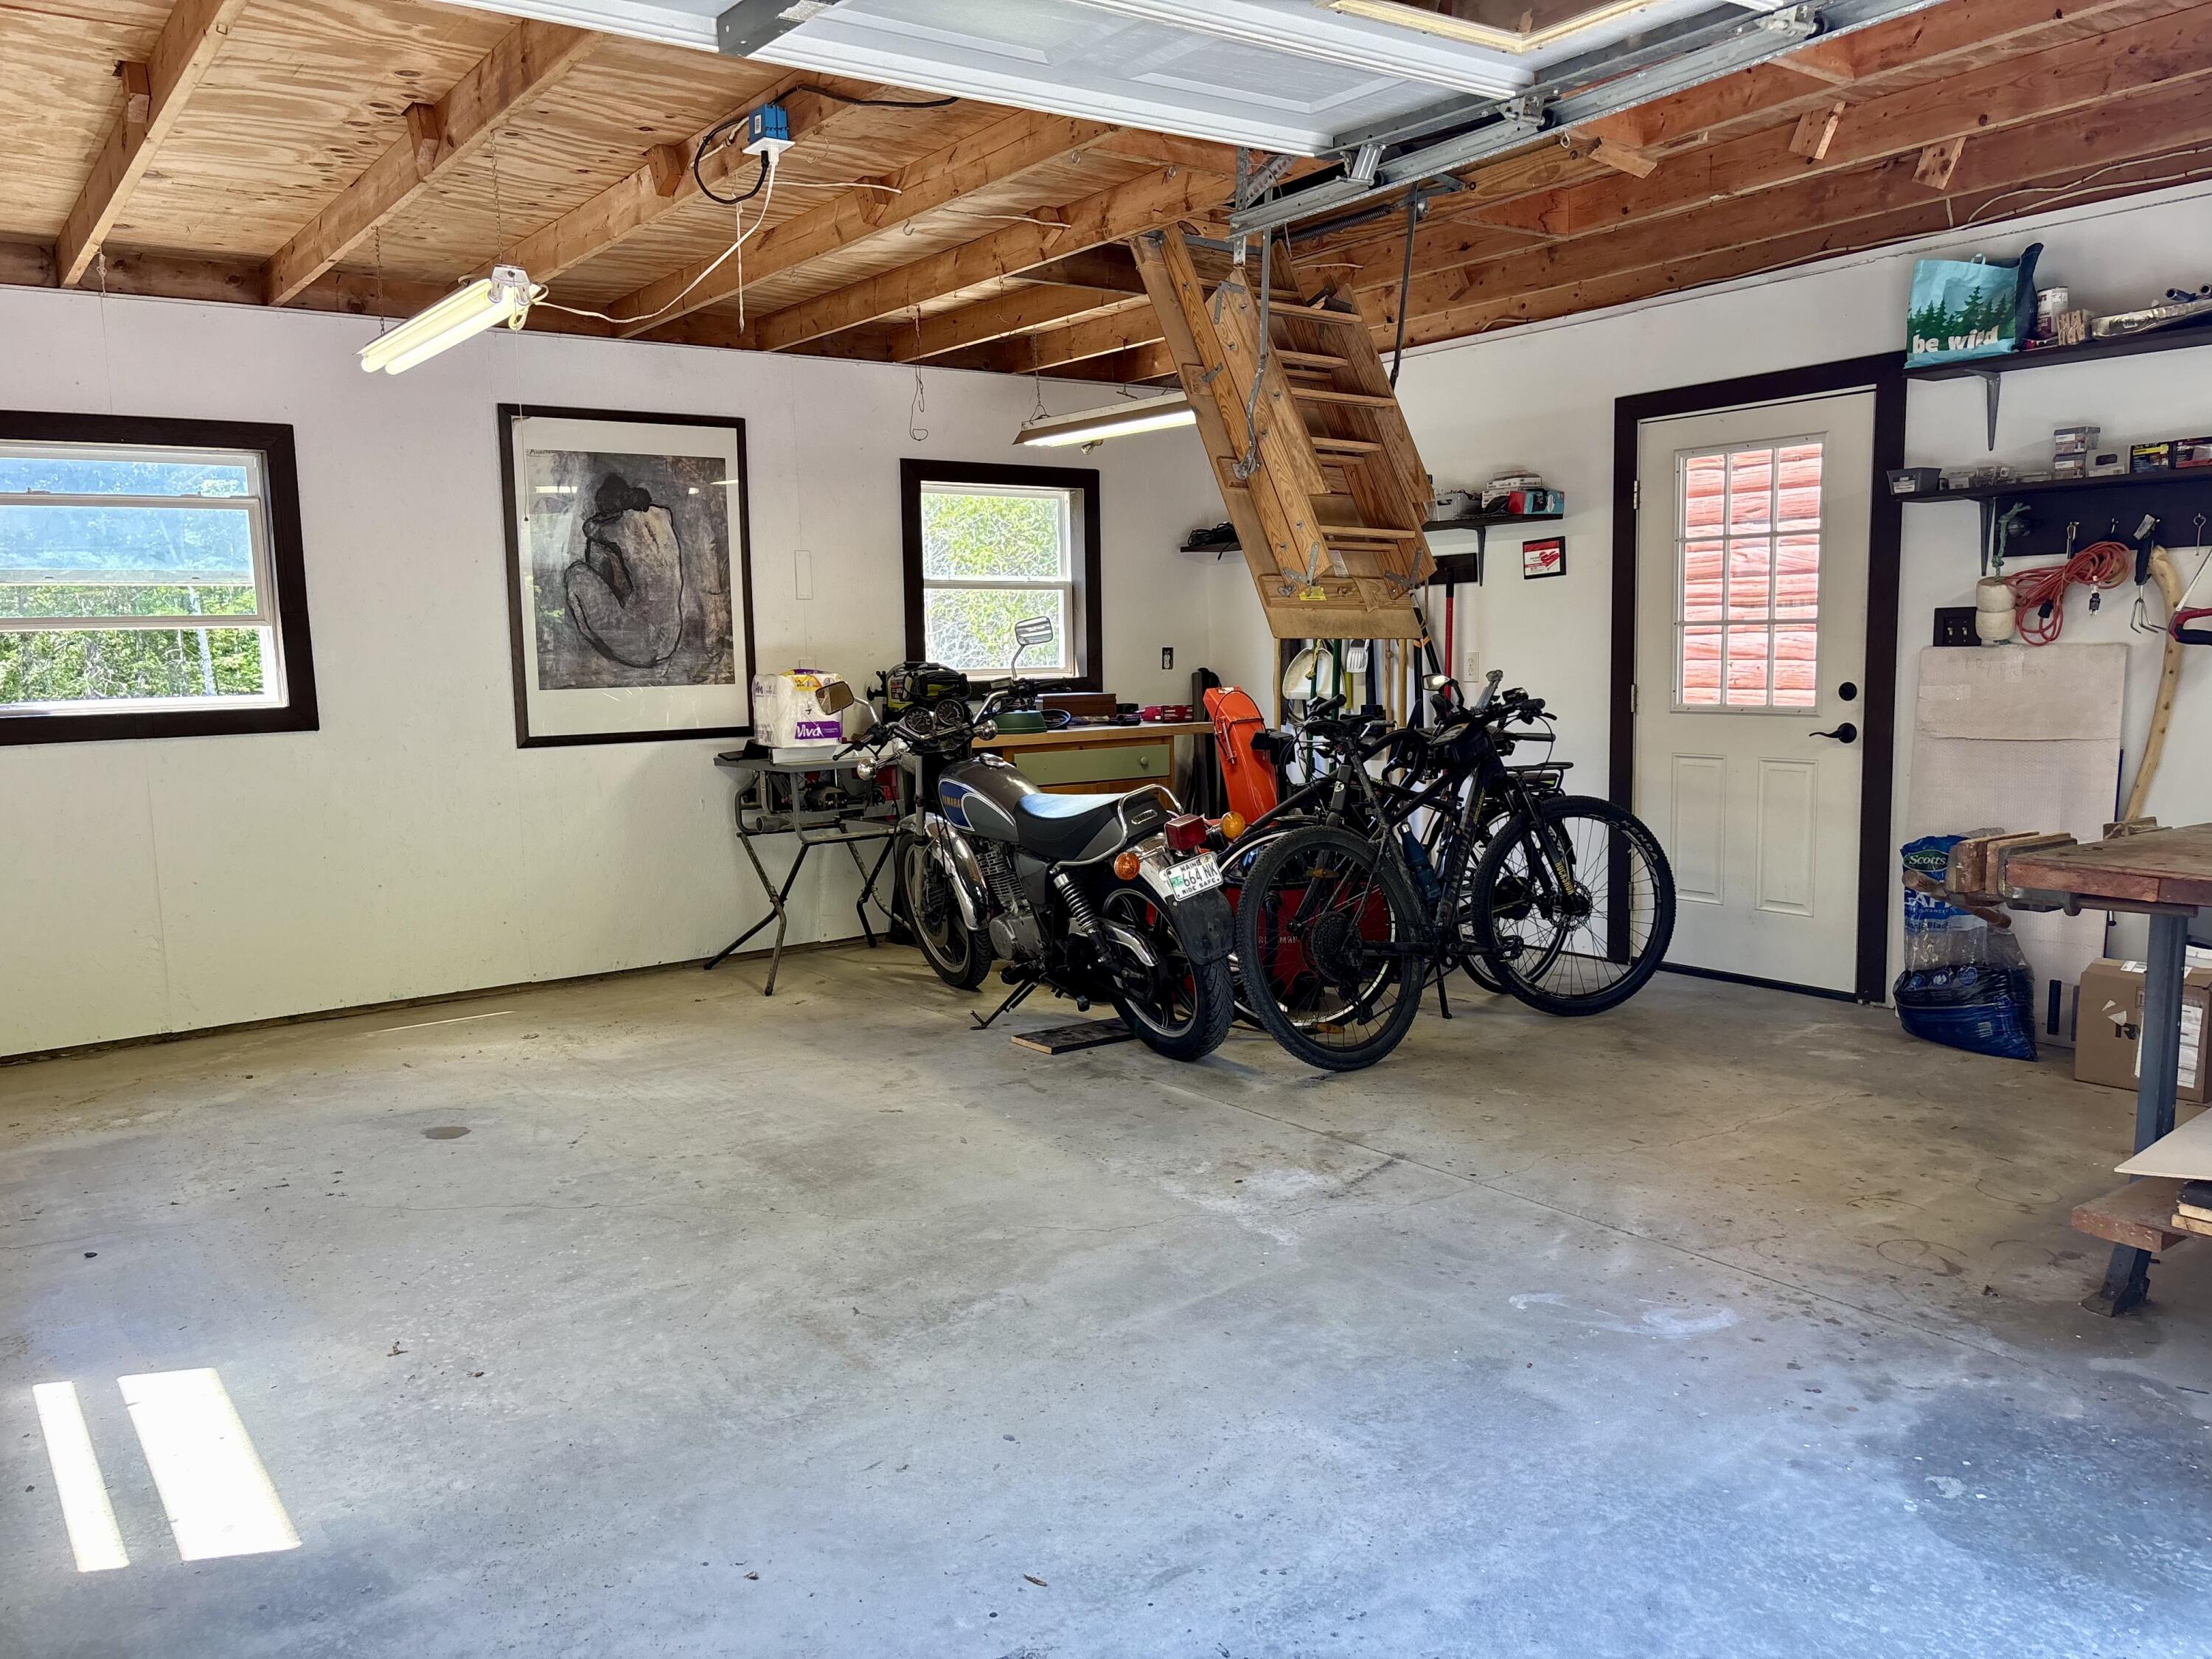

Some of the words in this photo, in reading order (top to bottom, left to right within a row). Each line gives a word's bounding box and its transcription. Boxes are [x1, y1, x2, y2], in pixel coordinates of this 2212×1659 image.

[1913, 334, 1938, 354] be
[1948, 324, 1999, 350] wild
[797, 724, 823, 737] Viva
[942, 796, 961, 809] YAMAHA
[1180, 859, 1202, 872] MAINE
[1909, 855, 1947, 865] Scotts
[1183, 868, 1203, 886] 664
[1202, 863, 1217, 878] NK
[1182, 886, 1197, 894] RIDE
[1199, 877, 1216, 888] SAFE
